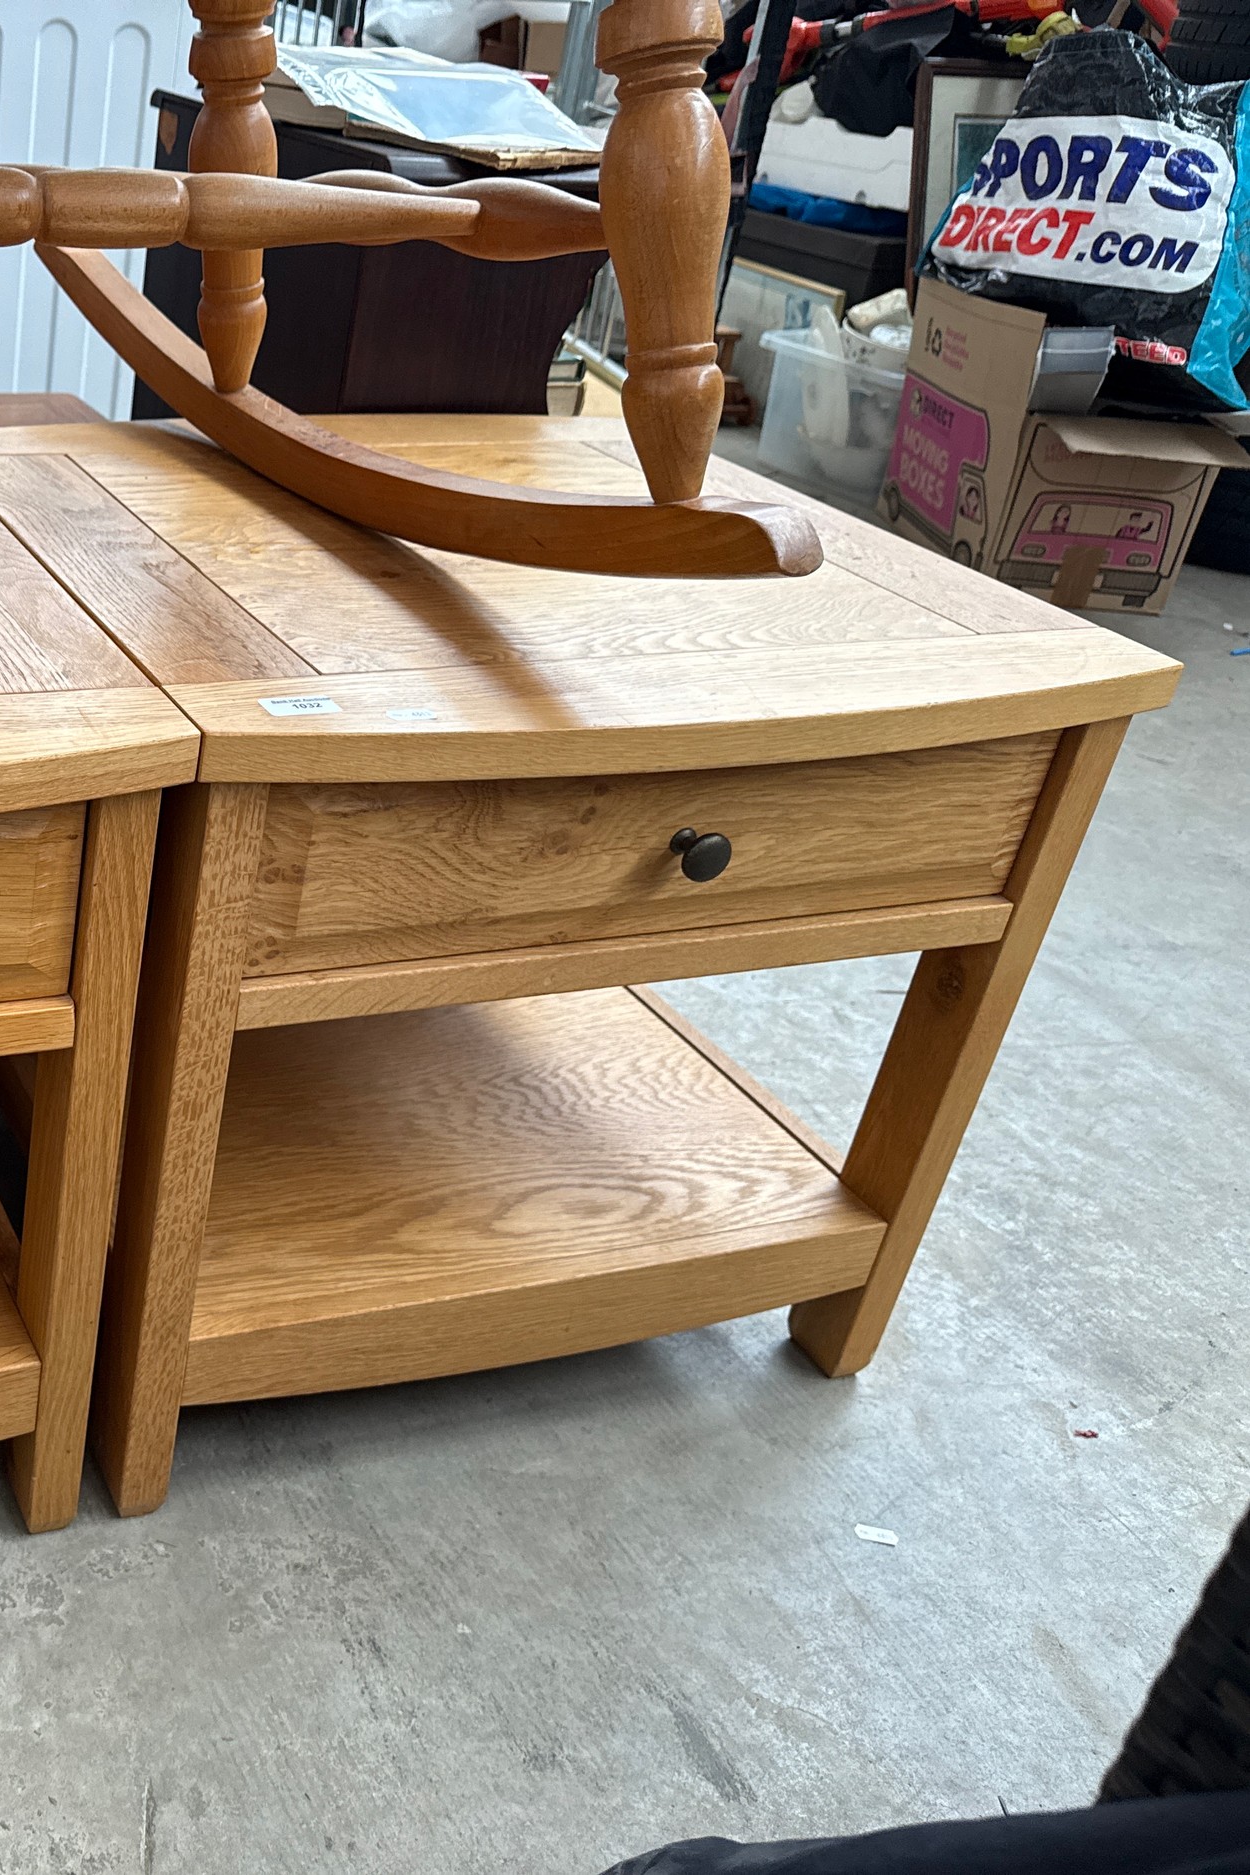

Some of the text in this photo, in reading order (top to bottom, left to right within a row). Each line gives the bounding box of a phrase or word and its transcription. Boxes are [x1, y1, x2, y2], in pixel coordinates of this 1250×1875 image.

[939, 204, 1200, 274] DIRECT.COM
[902, 424, 950, 474] MOVING
[899, 450, 946, 511] BOXES
[291, 702, 323, 710] 1032
